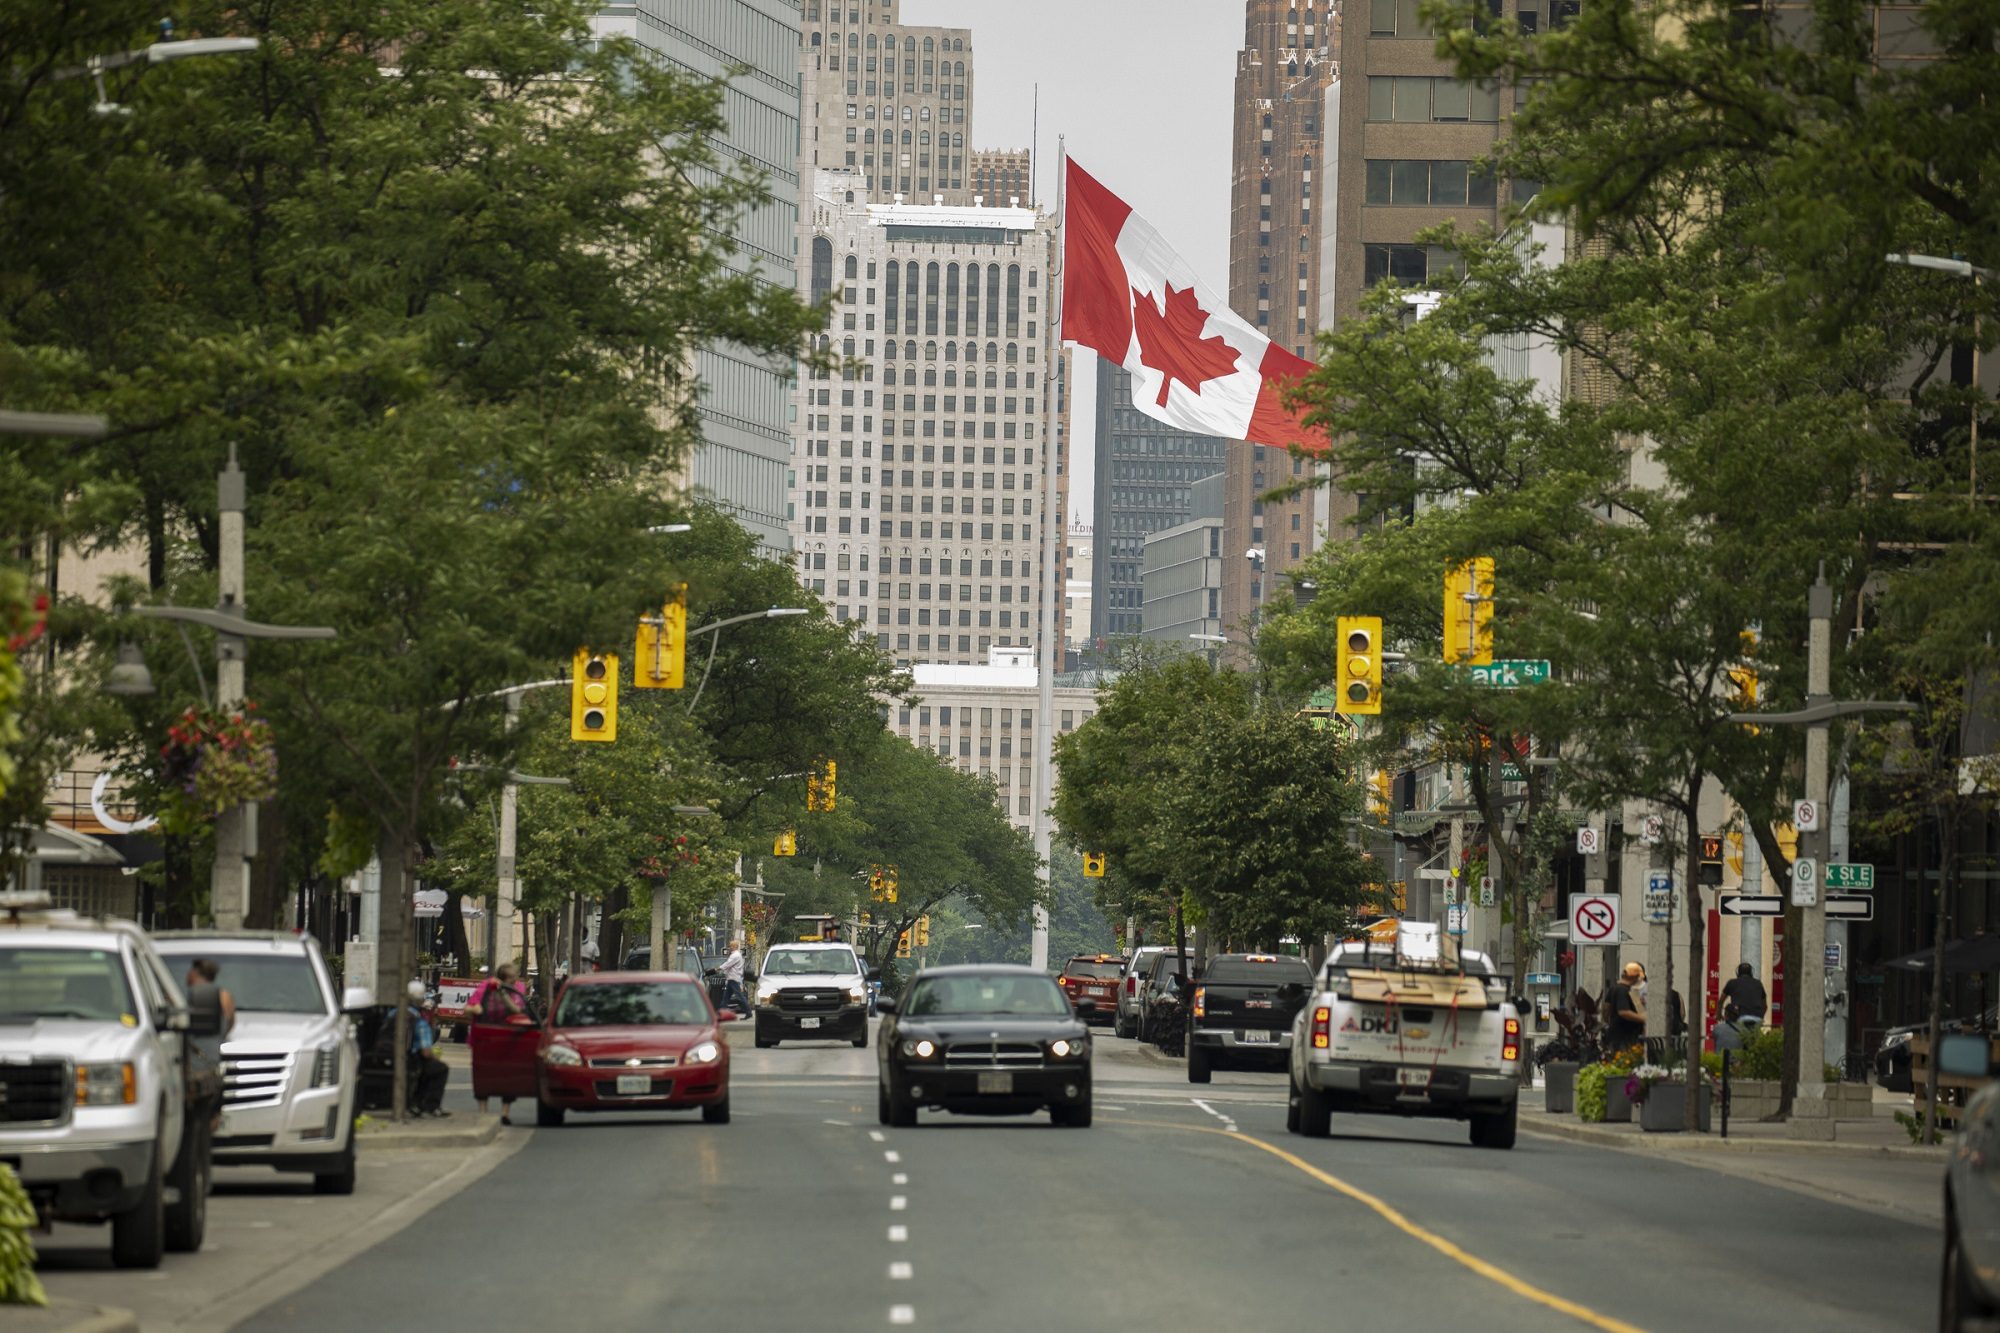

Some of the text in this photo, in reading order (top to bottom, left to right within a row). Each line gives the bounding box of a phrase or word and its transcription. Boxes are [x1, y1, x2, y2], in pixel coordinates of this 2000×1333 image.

[1524, 664, 1543, 676] St.
[1840, 866, 1855, 880] St
[1860, 867, 1870, 881] E
[1645, 894, 1679, 902] PARKIG
[1536, 974, 1551, 984] Bell
